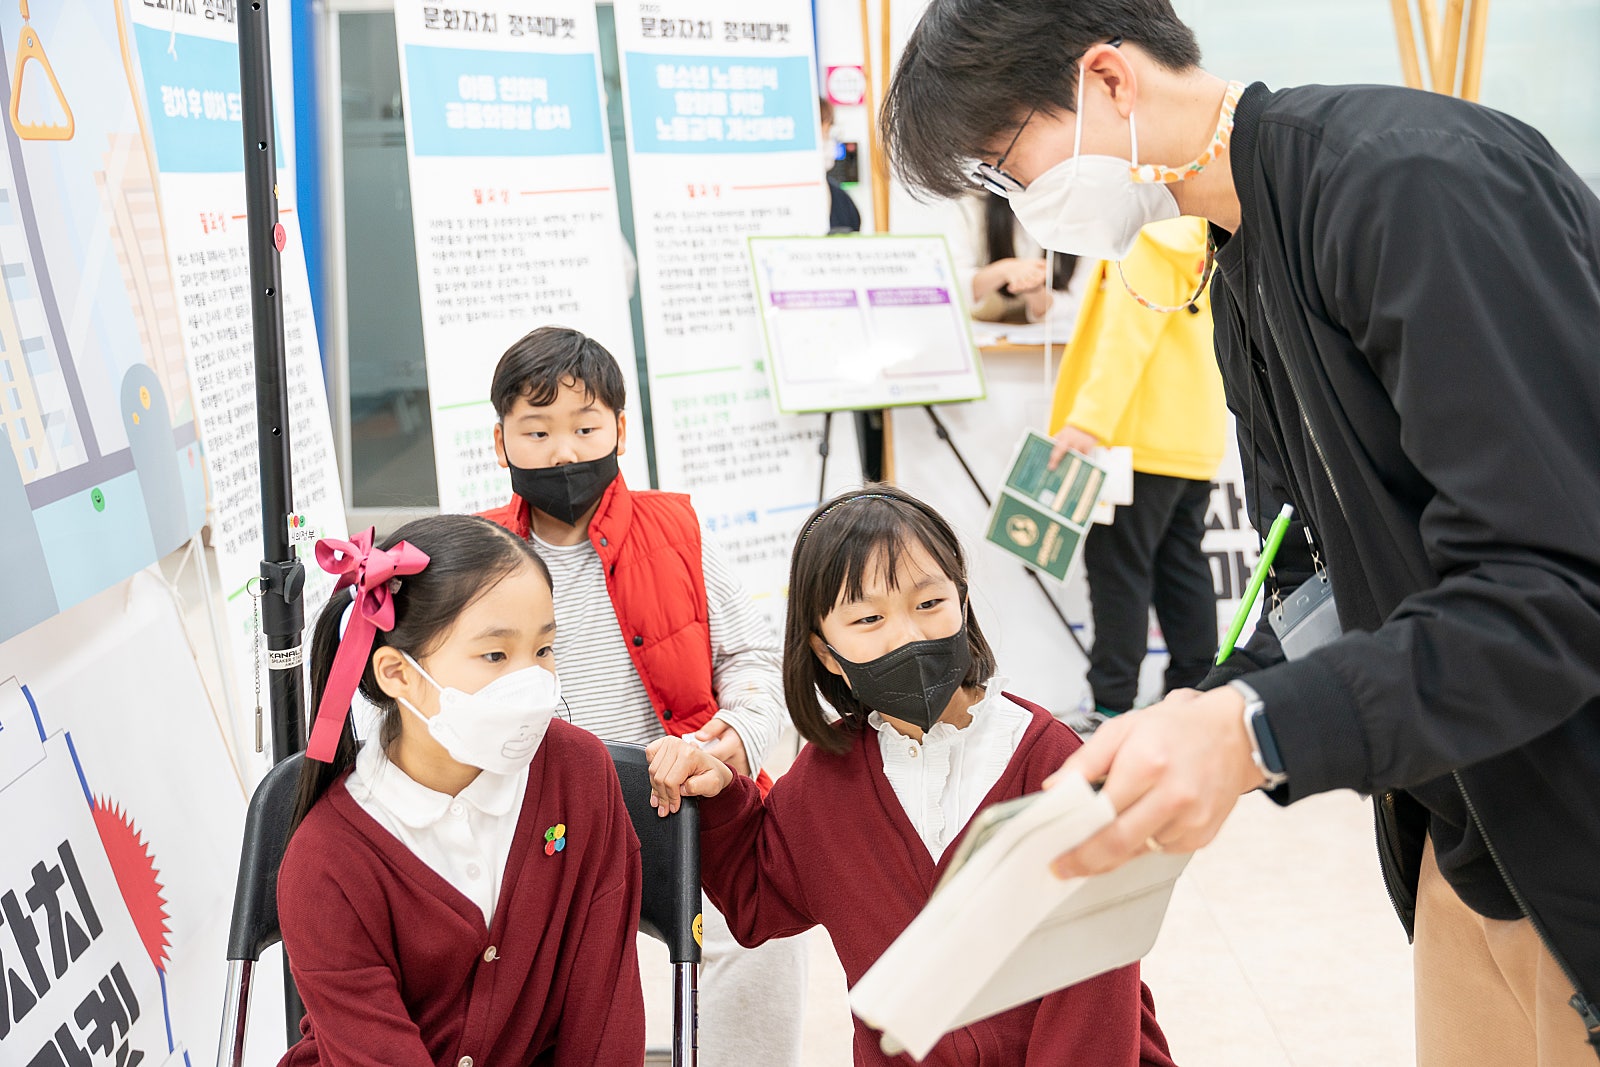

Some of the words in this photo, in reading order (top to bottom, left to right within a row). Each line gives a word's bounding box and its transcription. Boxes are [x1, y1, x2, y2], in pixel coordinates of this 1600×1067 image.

[424, 7, 497, 33] 문화자치
[508, 14, 576, 40] 정책마켓
[641, 17, 712, 39] 문화자치
[723, 21, 790, 43] 정책마켓
